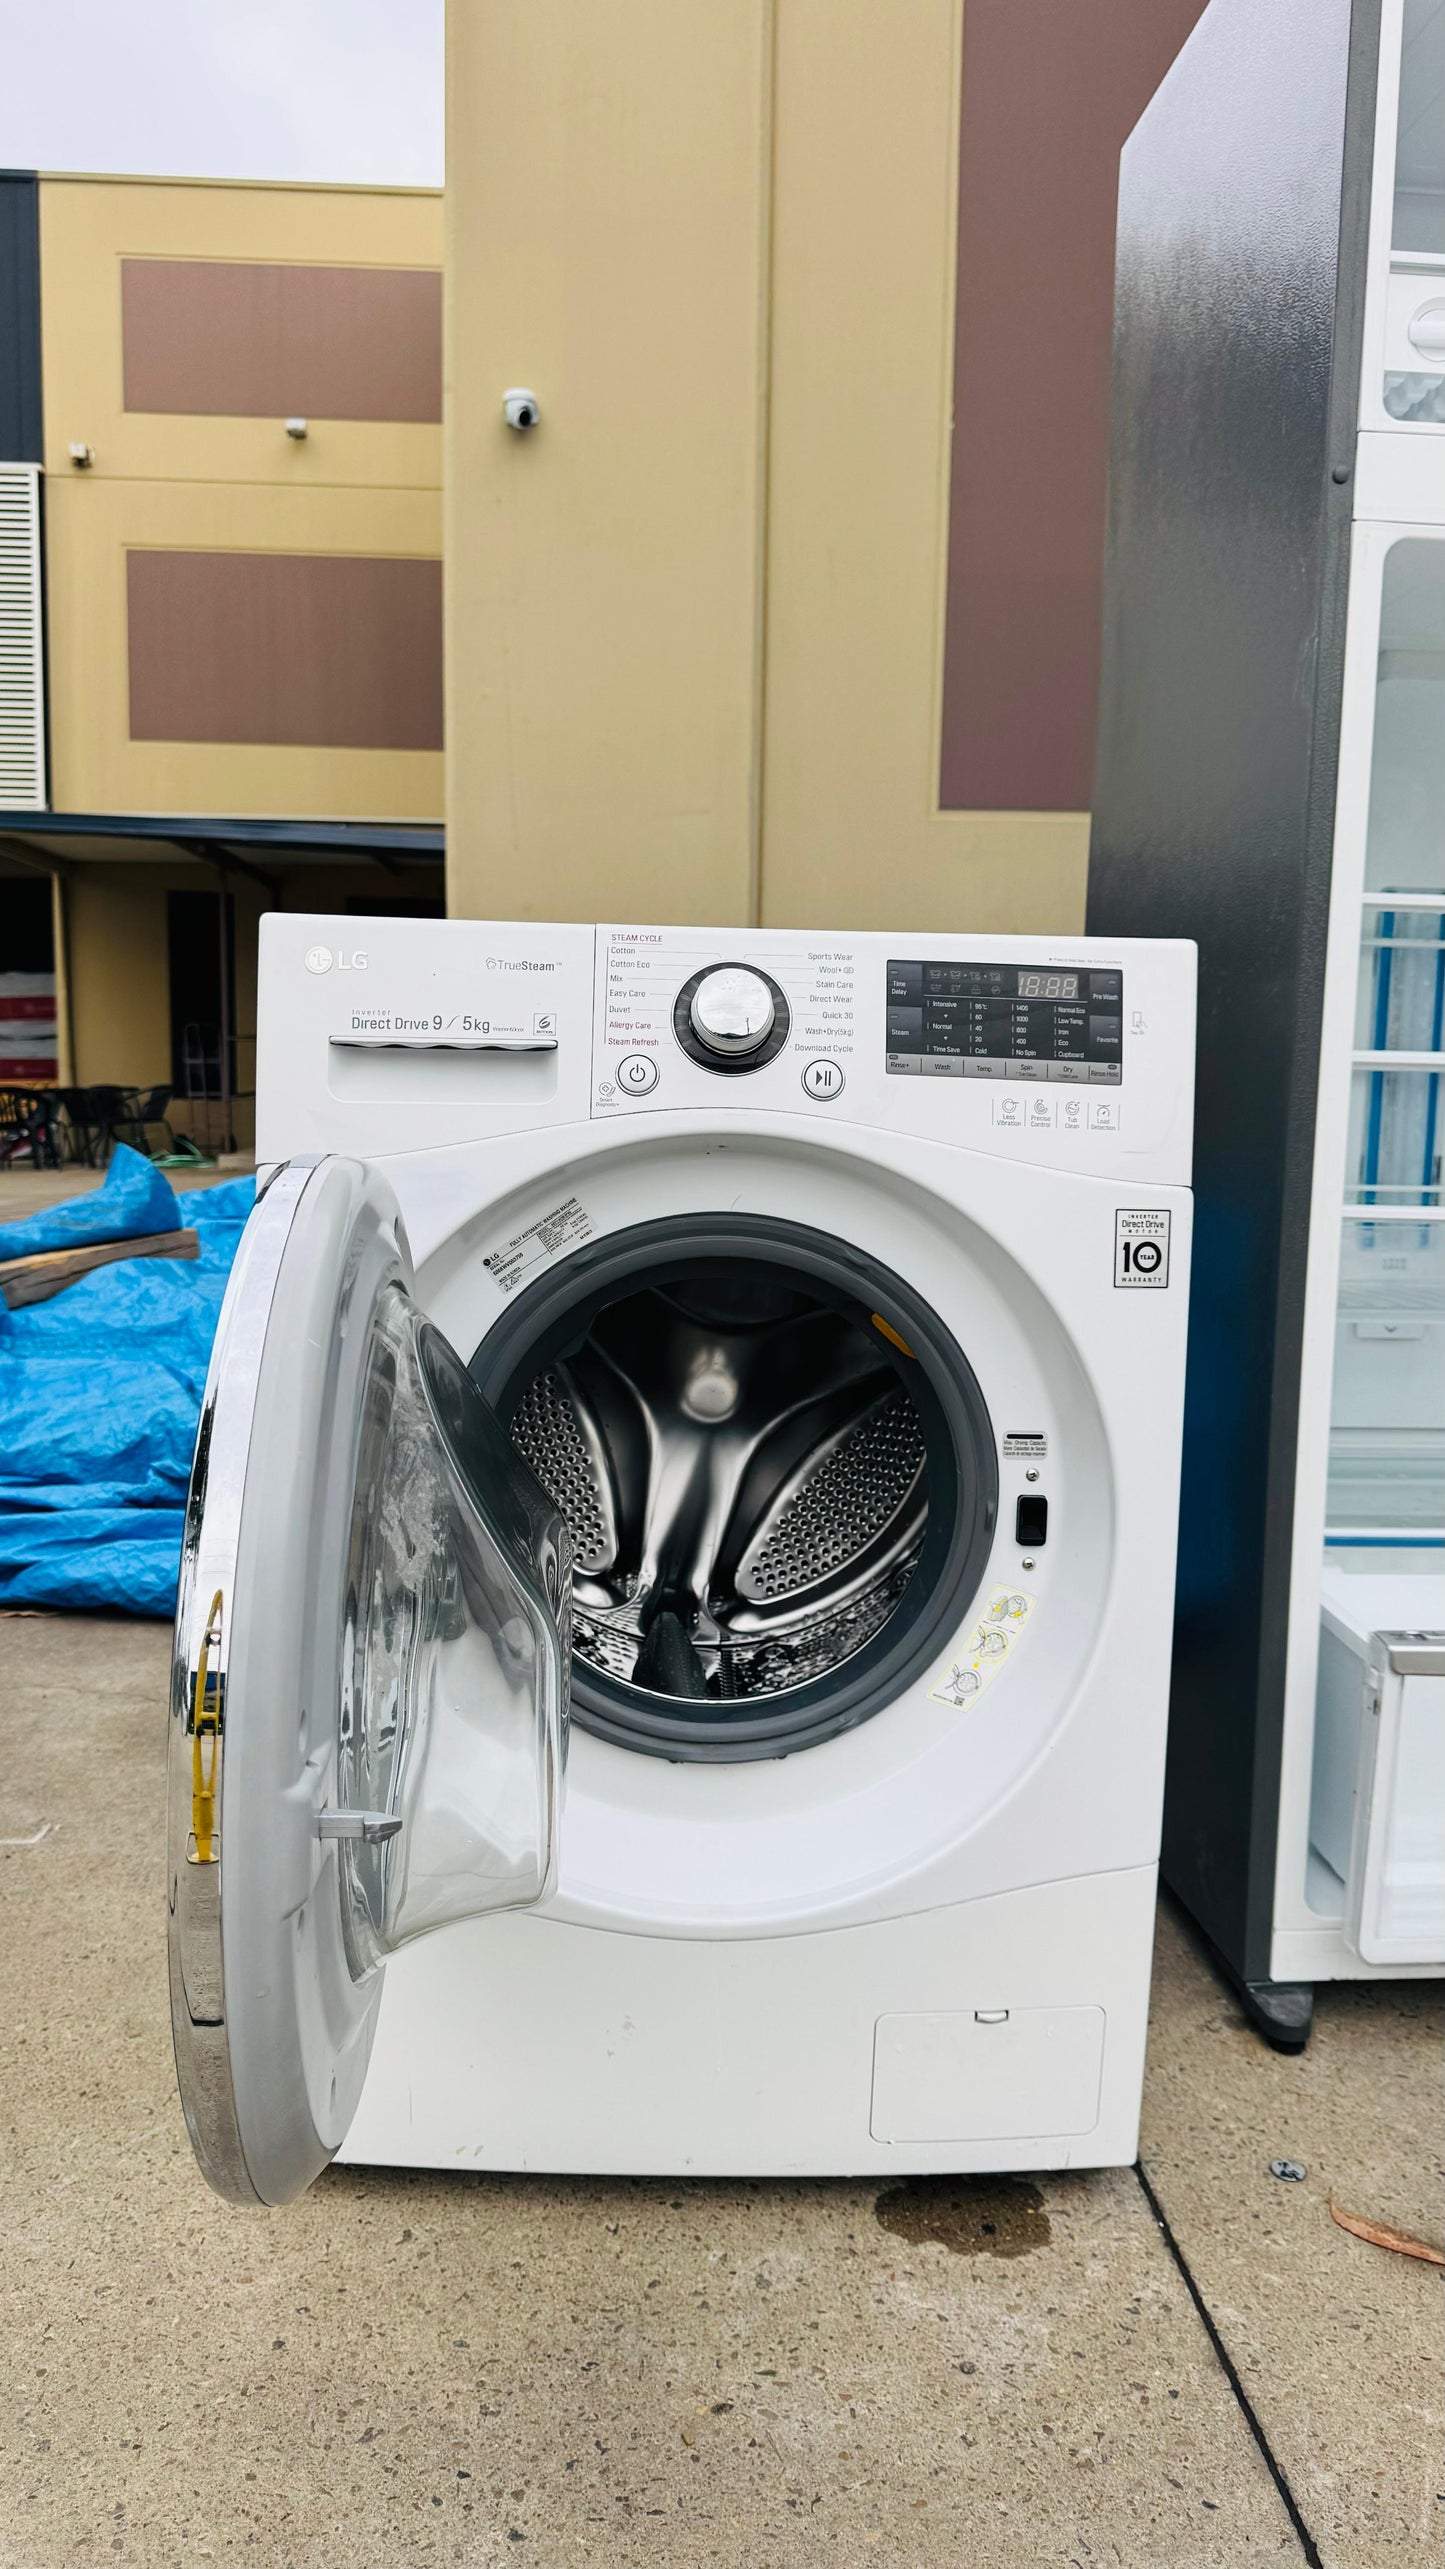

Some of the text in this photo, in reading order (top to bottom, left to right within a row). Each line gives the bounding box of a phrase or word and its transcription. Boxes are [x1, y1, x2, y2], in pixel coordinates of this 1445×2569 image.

[611, 946, 635, 954] Cotton
[338, 951, 368, 970] LG
[808, 953, 832, 961] Sports
[816, 980, 835, 988] Stain
[609, 989, 627, 998] Easy
[809, 995, 853, 1003] Direct Wear
[352, 1017, 391, 1029] Direct
[395, 1017, 429, 1030] Drive
[609, 1021, 634, 1030] Allergy
[608, 1037, 659, 1046] Steam Refresh
[1096, 1036, 1118, 1044] Favorite
[833, 1045, 853, 1053] Cycle
[509, 1236, 522, 1248] FULLY
[522, 1221, 544, 1240] AUTOMATIC
[543, 1209, 561, 1224] WASHING
[560, 1197, 578, 1213] MACHINE
[1122, 1220, 1164, 1228] Direct Drive
[490, 1253, 500, 1262] LG
[1123, 1241, 1162, 1273] 10
